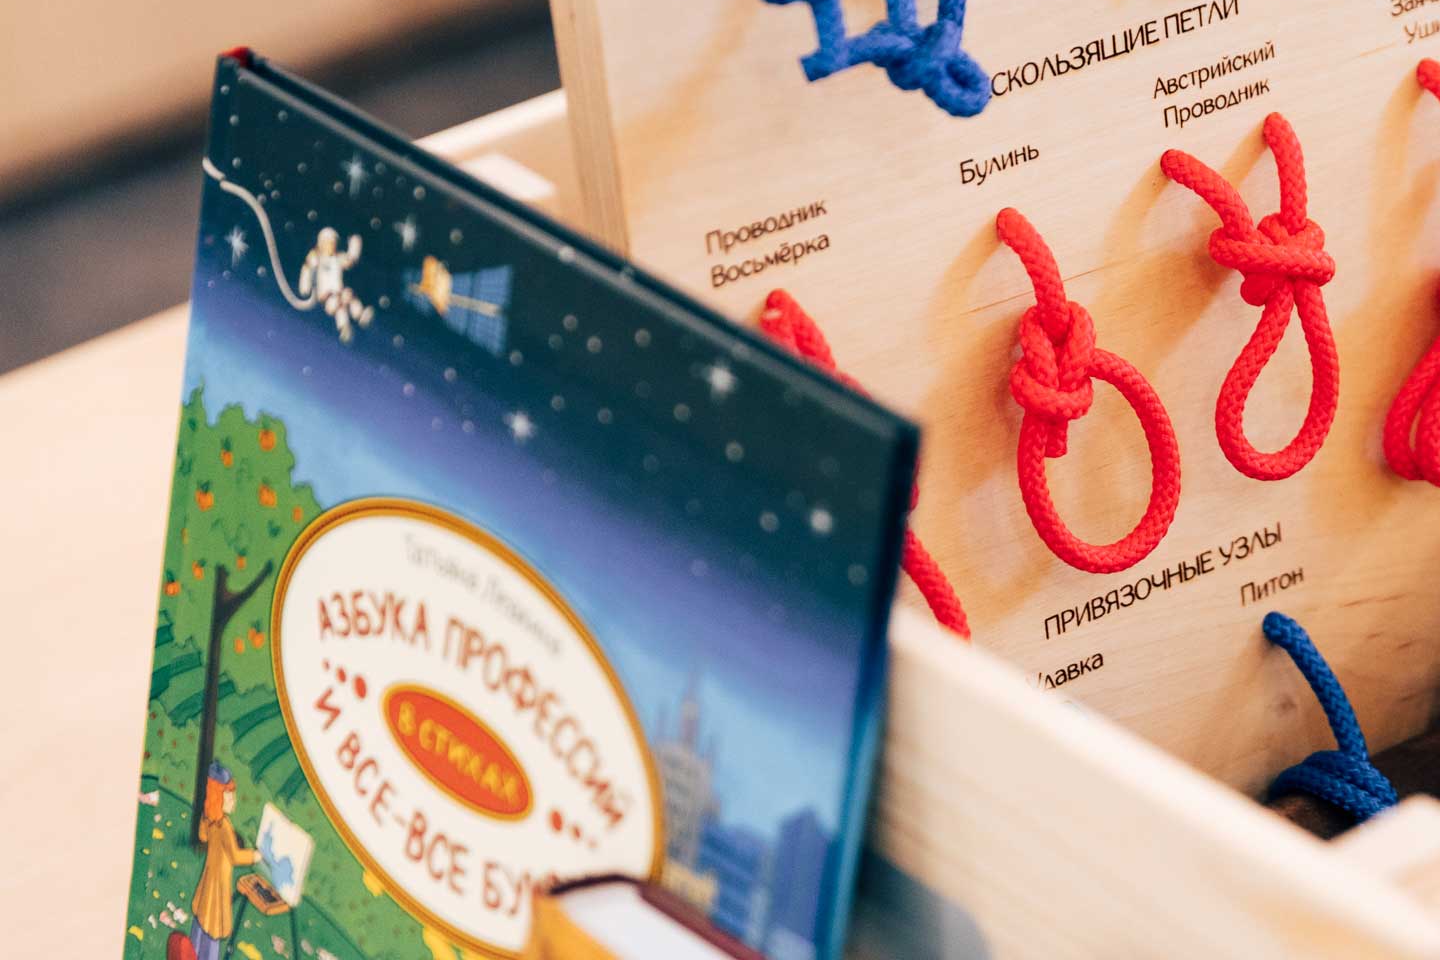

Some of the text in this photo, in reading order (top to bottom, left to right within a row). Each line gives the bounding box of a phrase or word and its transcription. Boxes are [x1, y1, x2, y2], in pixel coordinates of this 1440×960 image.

[988, 20, 1160, 98] СКОЛЬЗЯЩИЕ
[1153, 41, 1276, 100] Австрийский
[1162, 79, 1271, 129] Проводник
[959, 143, 1040, 186] Булинь
[705, 198, 828, 257] Проводник
[710, 233, 832, 289] Восьмёрка
[1043, 521, 1283, 640] ПРИВЯЗОЧНЫЕ УЗЛЫ
[1239, 566, 1305, 608] Питон
[317, 590, 431, 652] АЗБУКА
[441, 613, 634, 828] ПРОФЕССИЙ
[397, 699, 523, 805] В СТИХАХ
[313, 687, 560, 918] И ВСЕ-ВСЕ БУ
